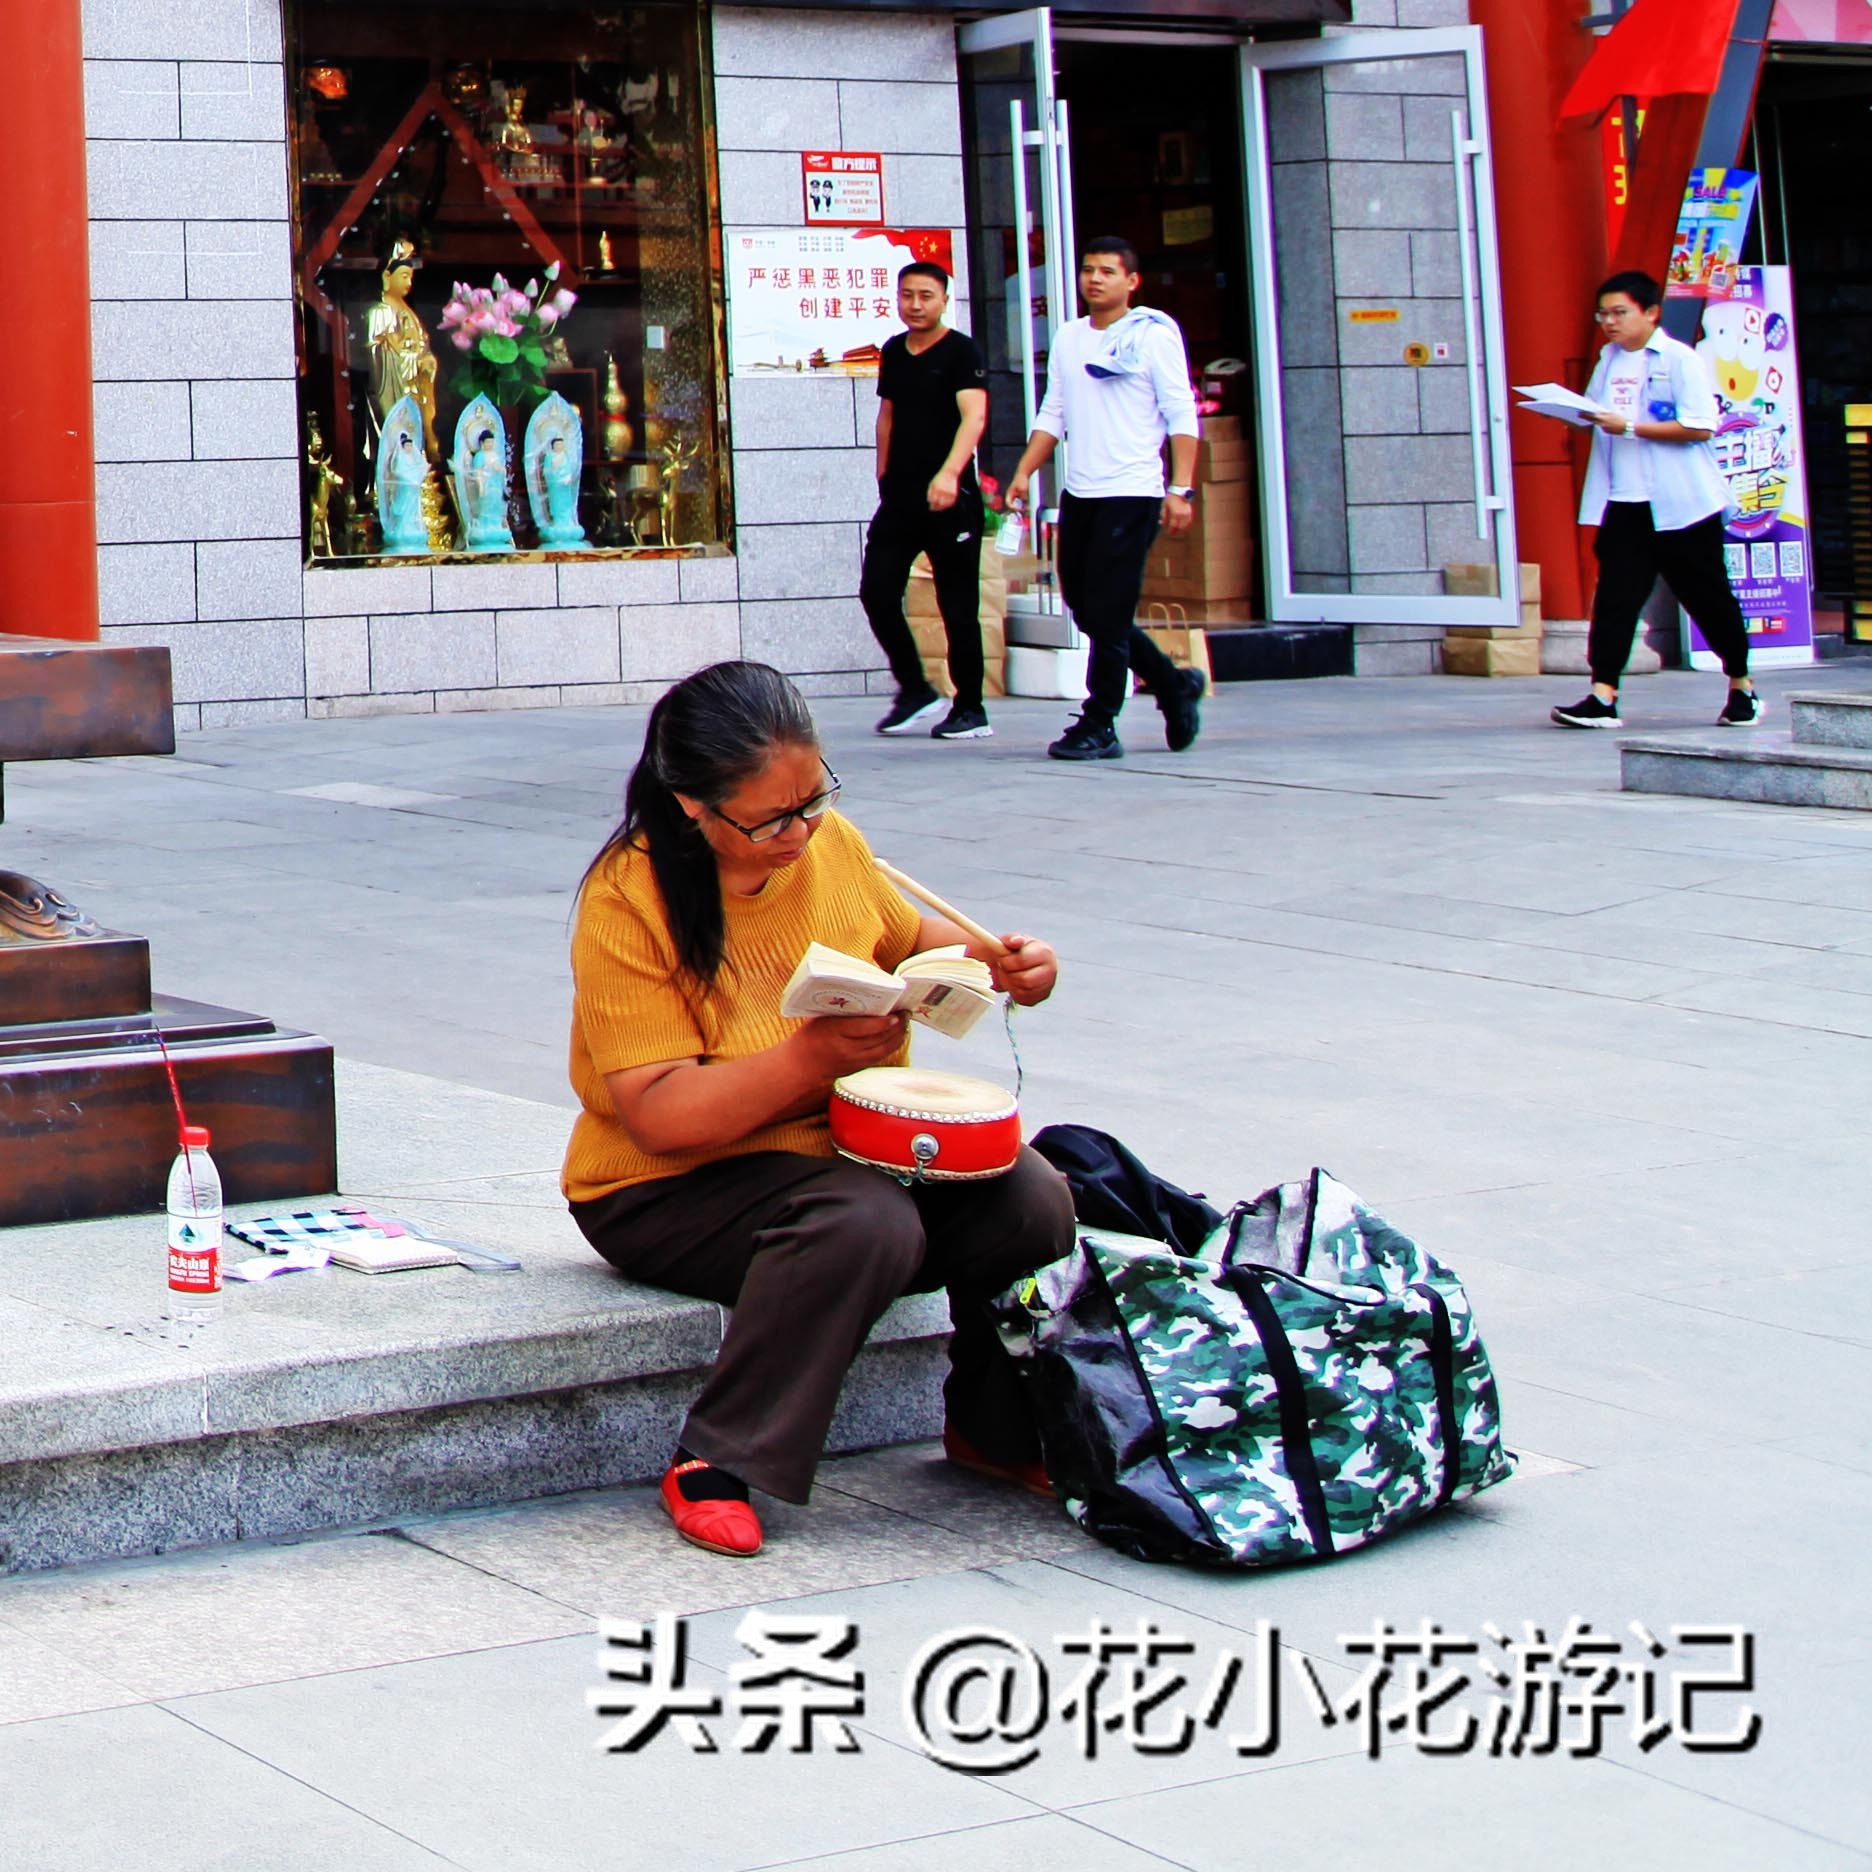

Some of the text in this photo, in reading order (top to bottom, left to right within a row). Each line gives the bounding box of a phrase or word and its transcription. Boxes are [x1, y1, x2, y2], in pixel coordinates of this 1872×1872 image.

[747, 267, 889, 289] 严惩黑恶犯罪
[799, 297, 892, 319] 创建平安
